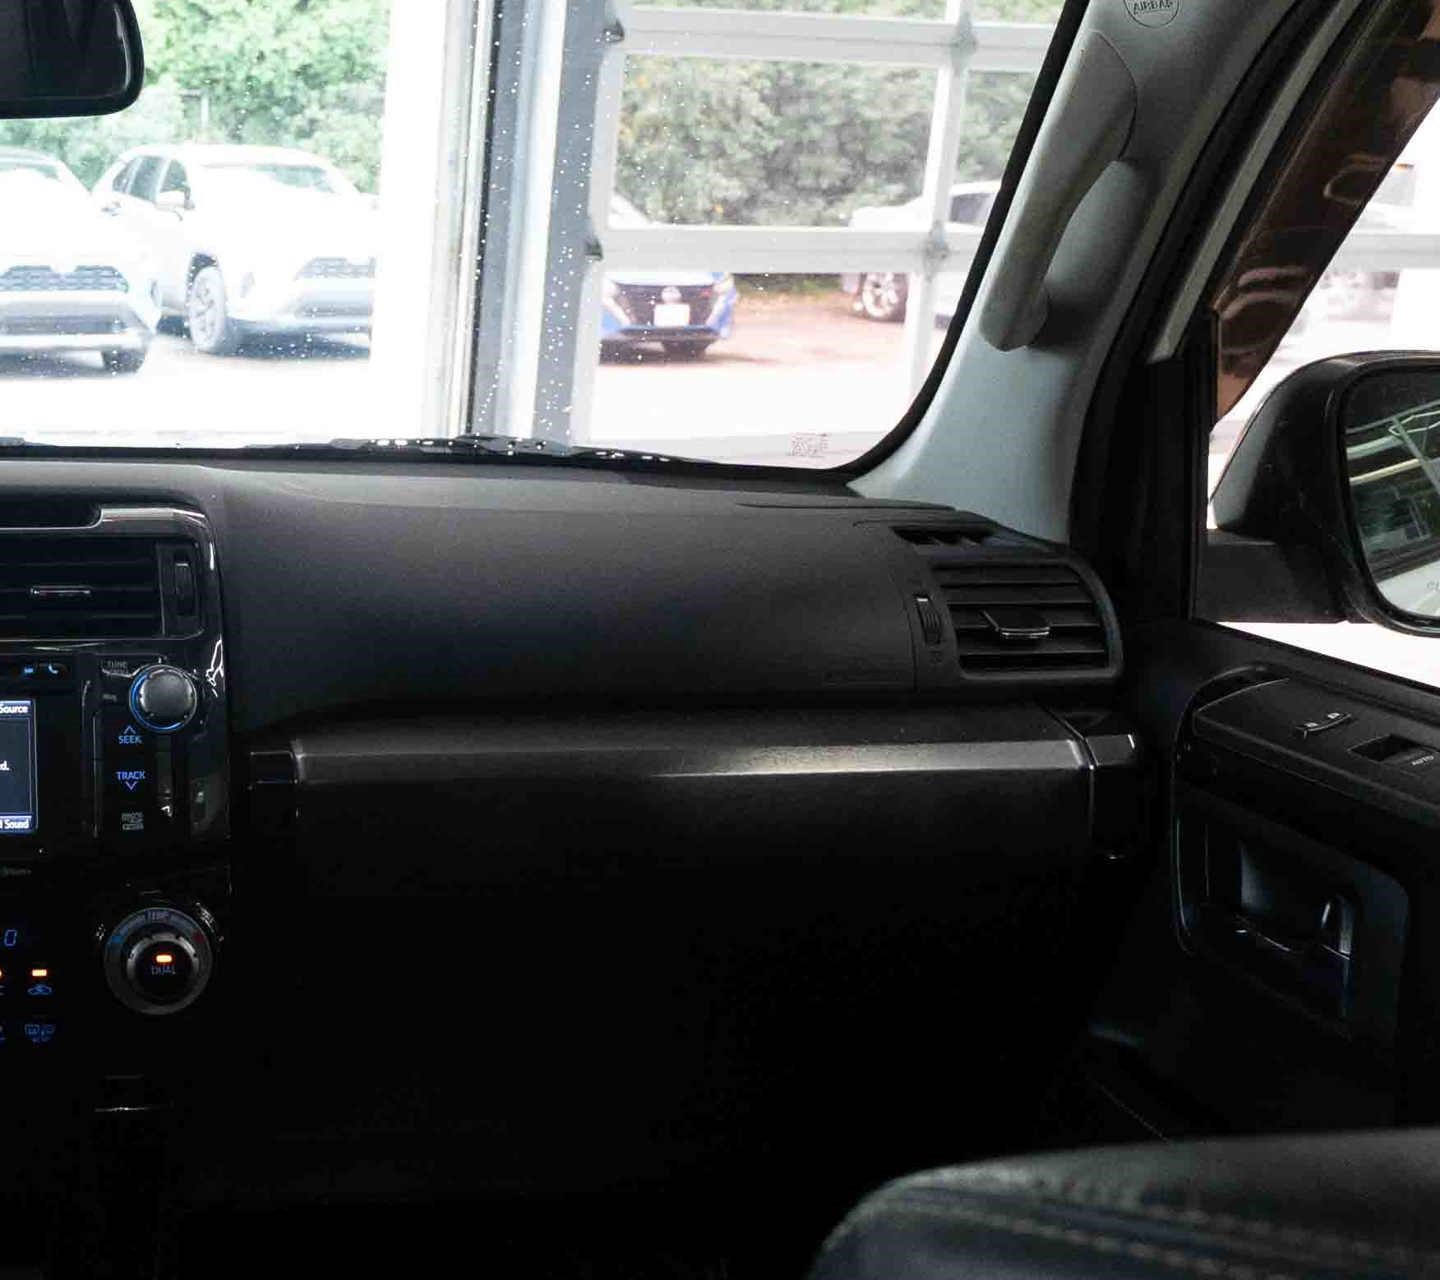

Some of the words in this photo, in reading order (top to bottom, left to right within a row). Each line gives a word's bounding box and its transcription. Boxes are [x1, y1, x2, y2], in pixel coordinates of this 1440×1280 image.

[118, 735, 144, 745] SEEK
[115, 771, 146, 781] TRACK
[3, 819, 30, 830] Sound
